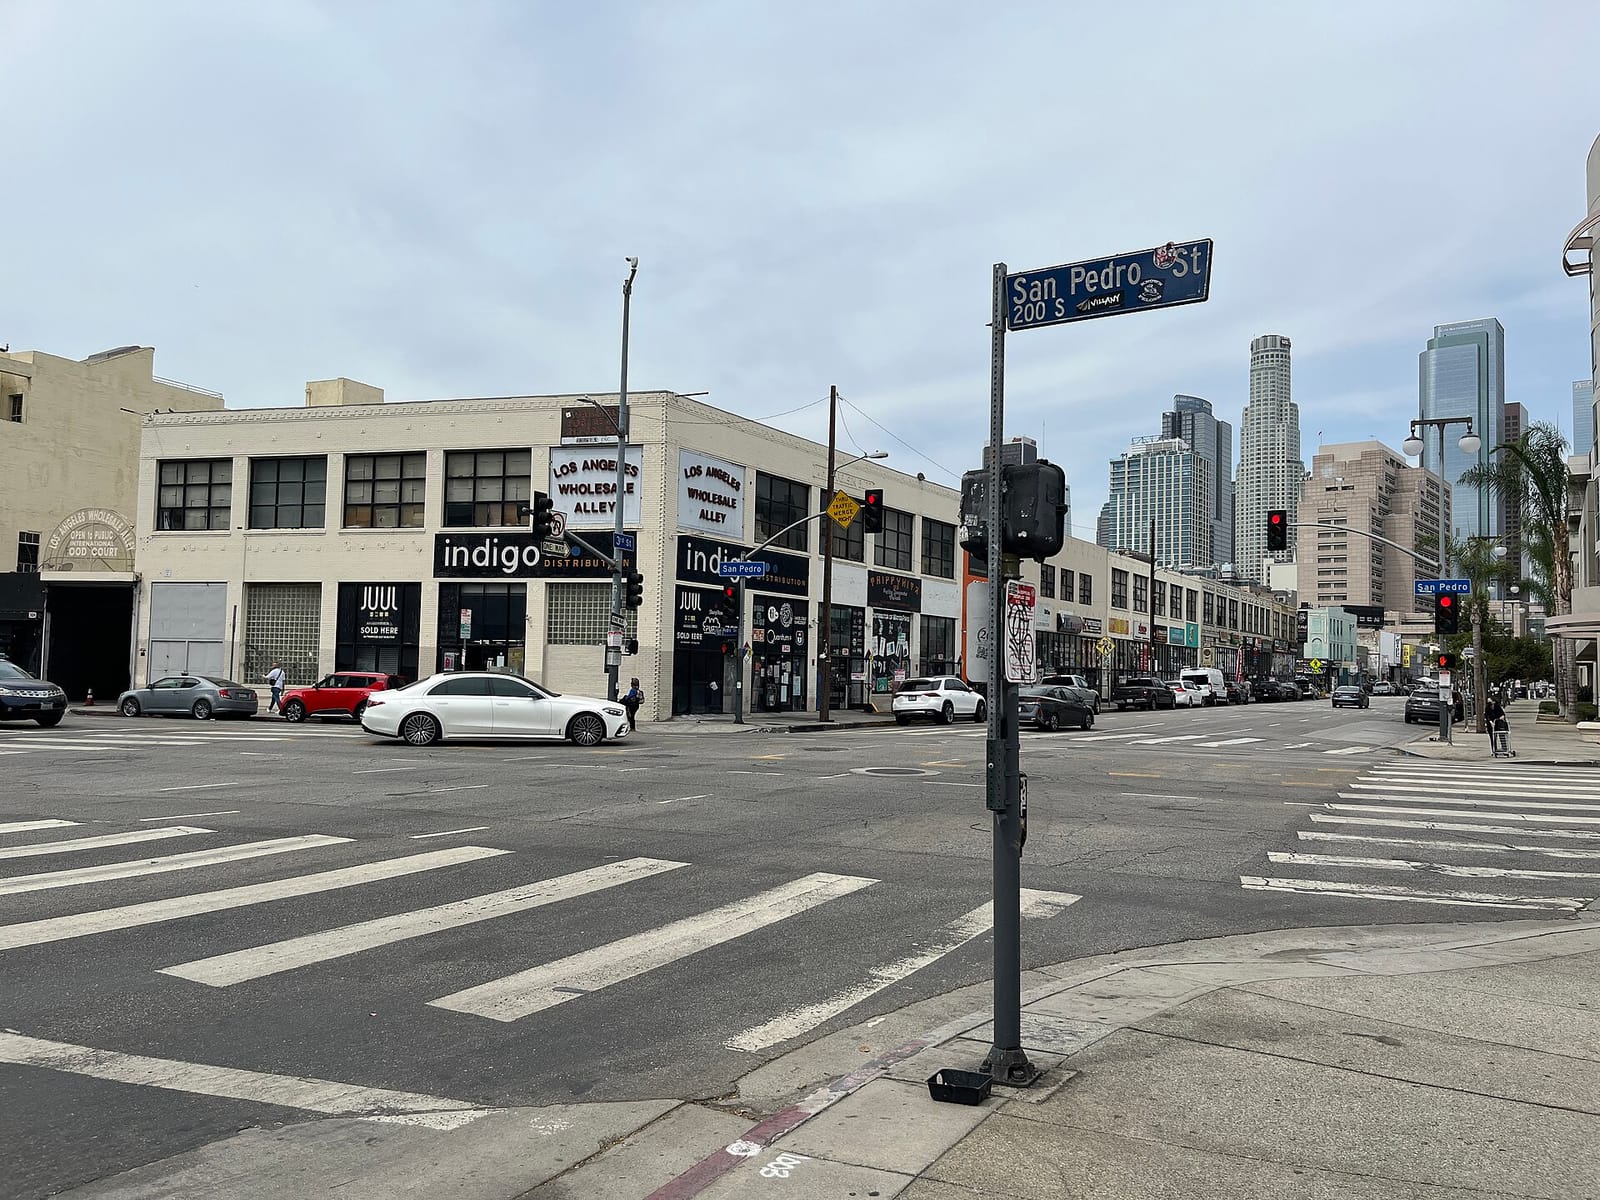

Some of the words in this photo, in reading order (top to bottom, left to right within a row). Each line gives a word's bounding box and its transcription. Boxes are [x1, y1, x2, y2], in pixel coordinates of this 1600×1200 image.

[1013, 277, 1056, 304] San
[1070, 260, 1141, 296] Pedro
[1172, 246, 1202, 278] St
[1014, 302, 1046, 324] 200
[1054, 298, 1064, 317] S
[554, 462, 578, 478] LOS
[684, 465, 702, 478] LOS
[706, 466, 740, 492] ANGELES
[558, 483, 634, 494] WHOLESAE
[688, 487, 736, 509] WHOLESALE
[574, 502, 616, 514] ALLEY
[699, 508, 726, 524] ALLEY
[48, 534, 60, 549] LOS
[59, 512, 85, 536] ANGELES
[88, 510, 124, 531] WHOLESALE
[70, 531, 85, 539] OPEN
[94, 531, 114, 539] PUBLIC
[91, 547, 118, 556] COURT
[444, 538, 540, 574] indigo
[544, 559, 630, 568] DISTRIBUTN
[360, 586, 398, 610] JUUL
[680, 592, 701, 611] JUUL
